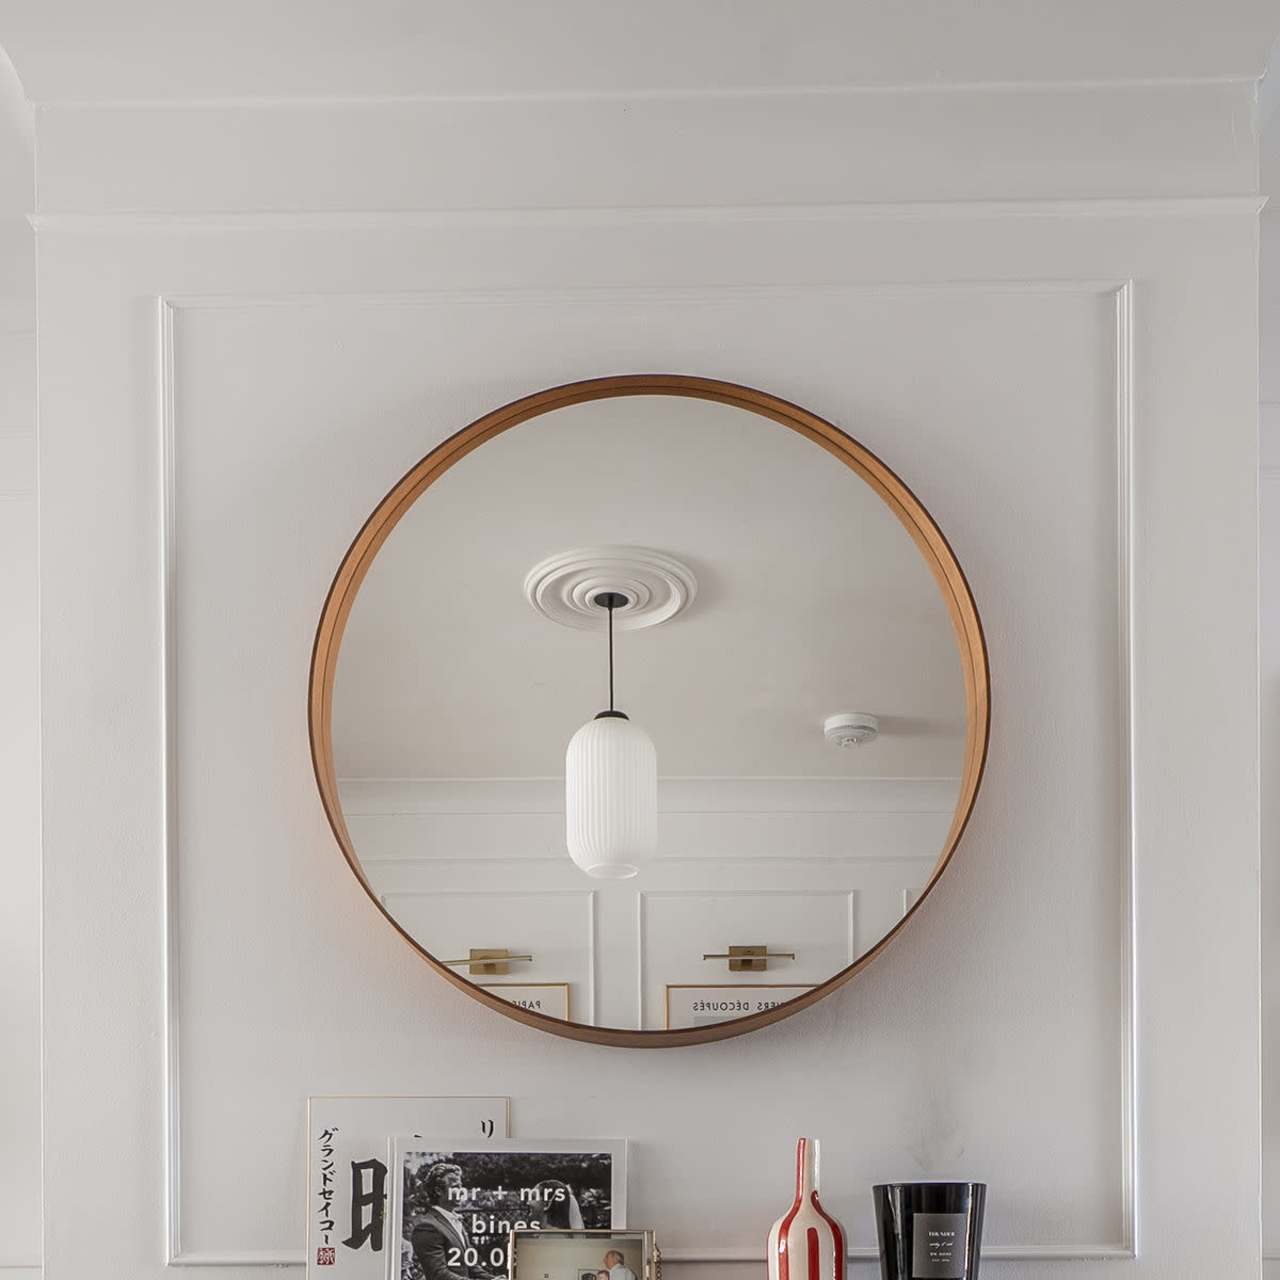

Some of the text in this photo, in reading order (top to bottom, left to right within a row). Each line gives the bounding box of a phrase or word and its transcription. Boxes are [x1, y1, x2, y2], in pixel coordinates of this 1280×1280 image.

[317, 1126, 340, 1246] グランドセイコー
[448, 1187, 481, 1201] mr
[520, 1187, 566, 1202] mrs
[472, 1213, 541, 1234] bines
